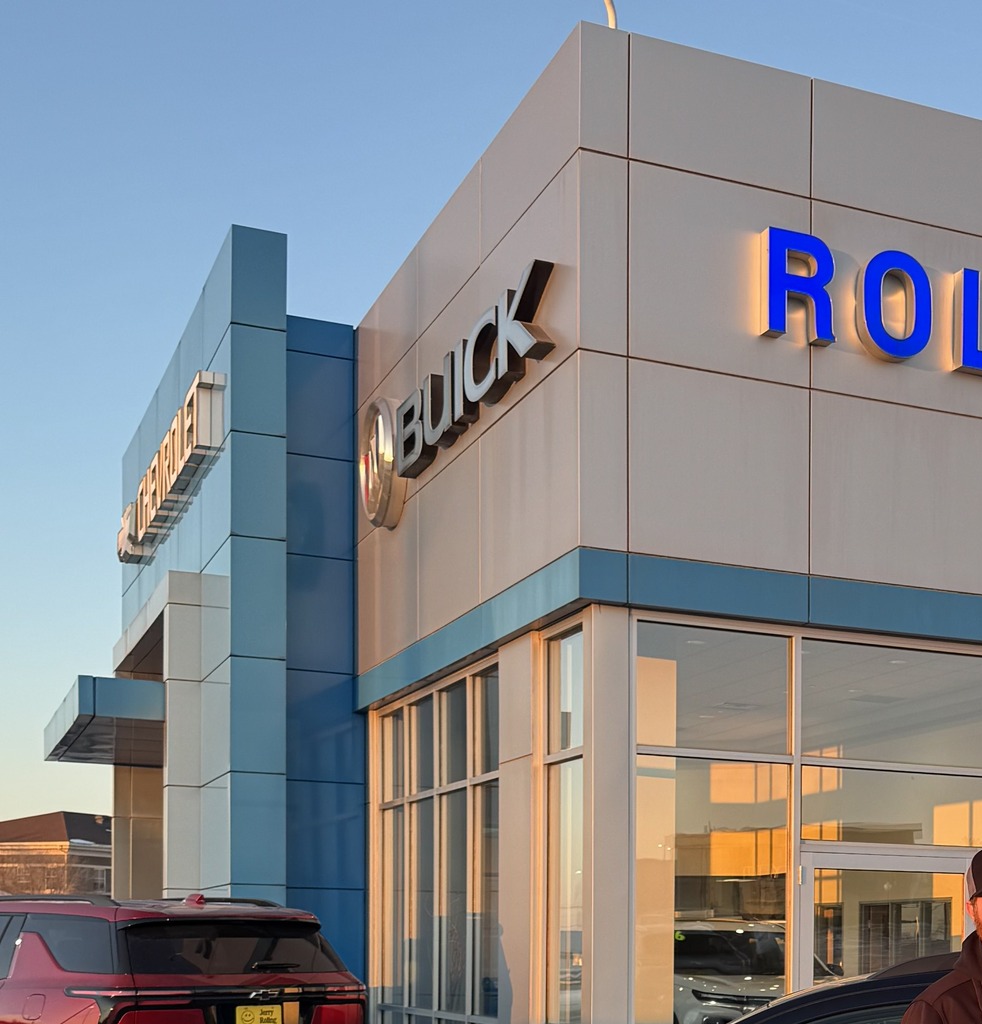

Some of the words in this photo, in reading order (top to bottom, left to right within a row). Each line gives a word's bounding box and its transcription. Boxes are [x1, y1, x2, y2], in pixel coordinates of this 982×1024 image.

[397, 259, 556, 479] BUICK
[135, 370, 215, 547] CHEVROLET
[259, 1009, 274, 1017] Jerry
